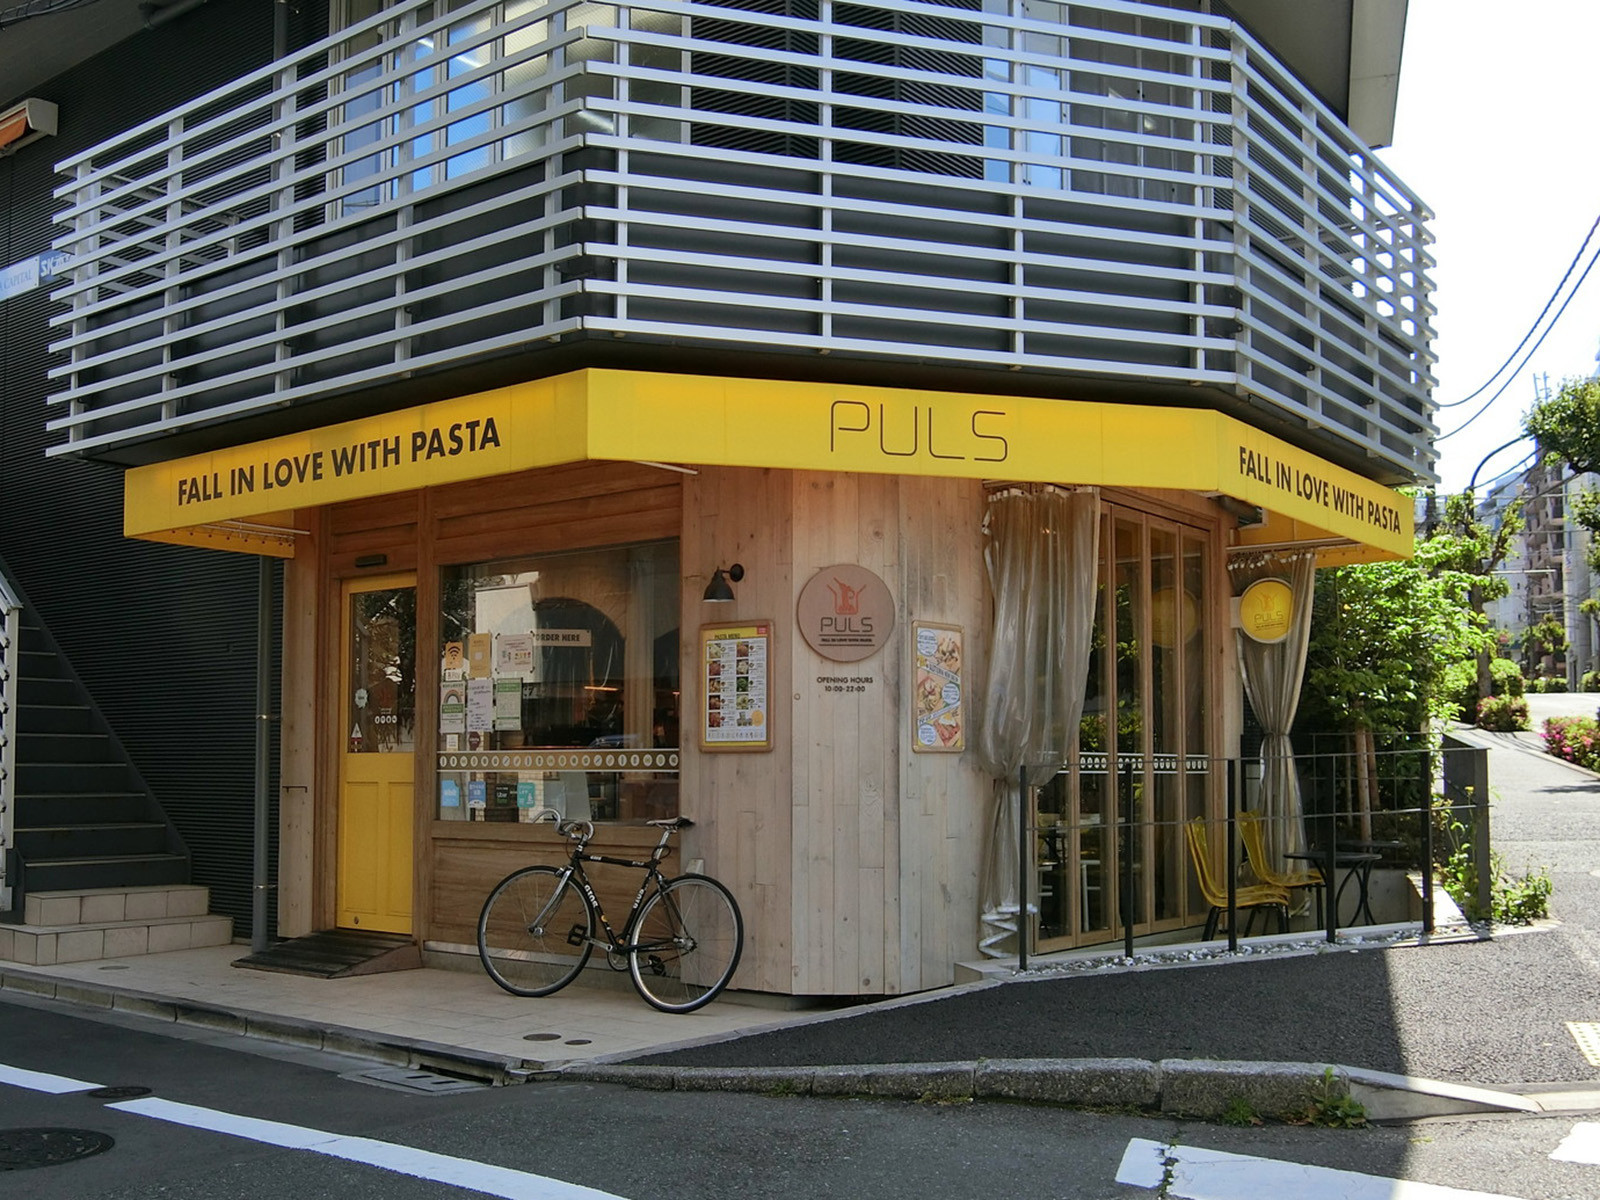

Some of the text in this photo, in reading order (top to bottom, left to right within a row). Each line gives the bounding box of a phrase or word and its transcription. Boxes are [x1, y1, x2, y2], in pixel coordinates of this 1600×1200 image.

[831, 400, 1008, 462] PULS
[178, 417, 501, 506] FALL IN LOVE WITH PASTA
[1239, 446, 1401, 535] FALL IN LOVE WITH PASTA
[820, 617, 873, 633] PULS
[1254, 611, 1284, 624] PULS
[535, 633, 580, 641] ORDER HERE
[816, 676, 874, 684] OPENING HOURS
